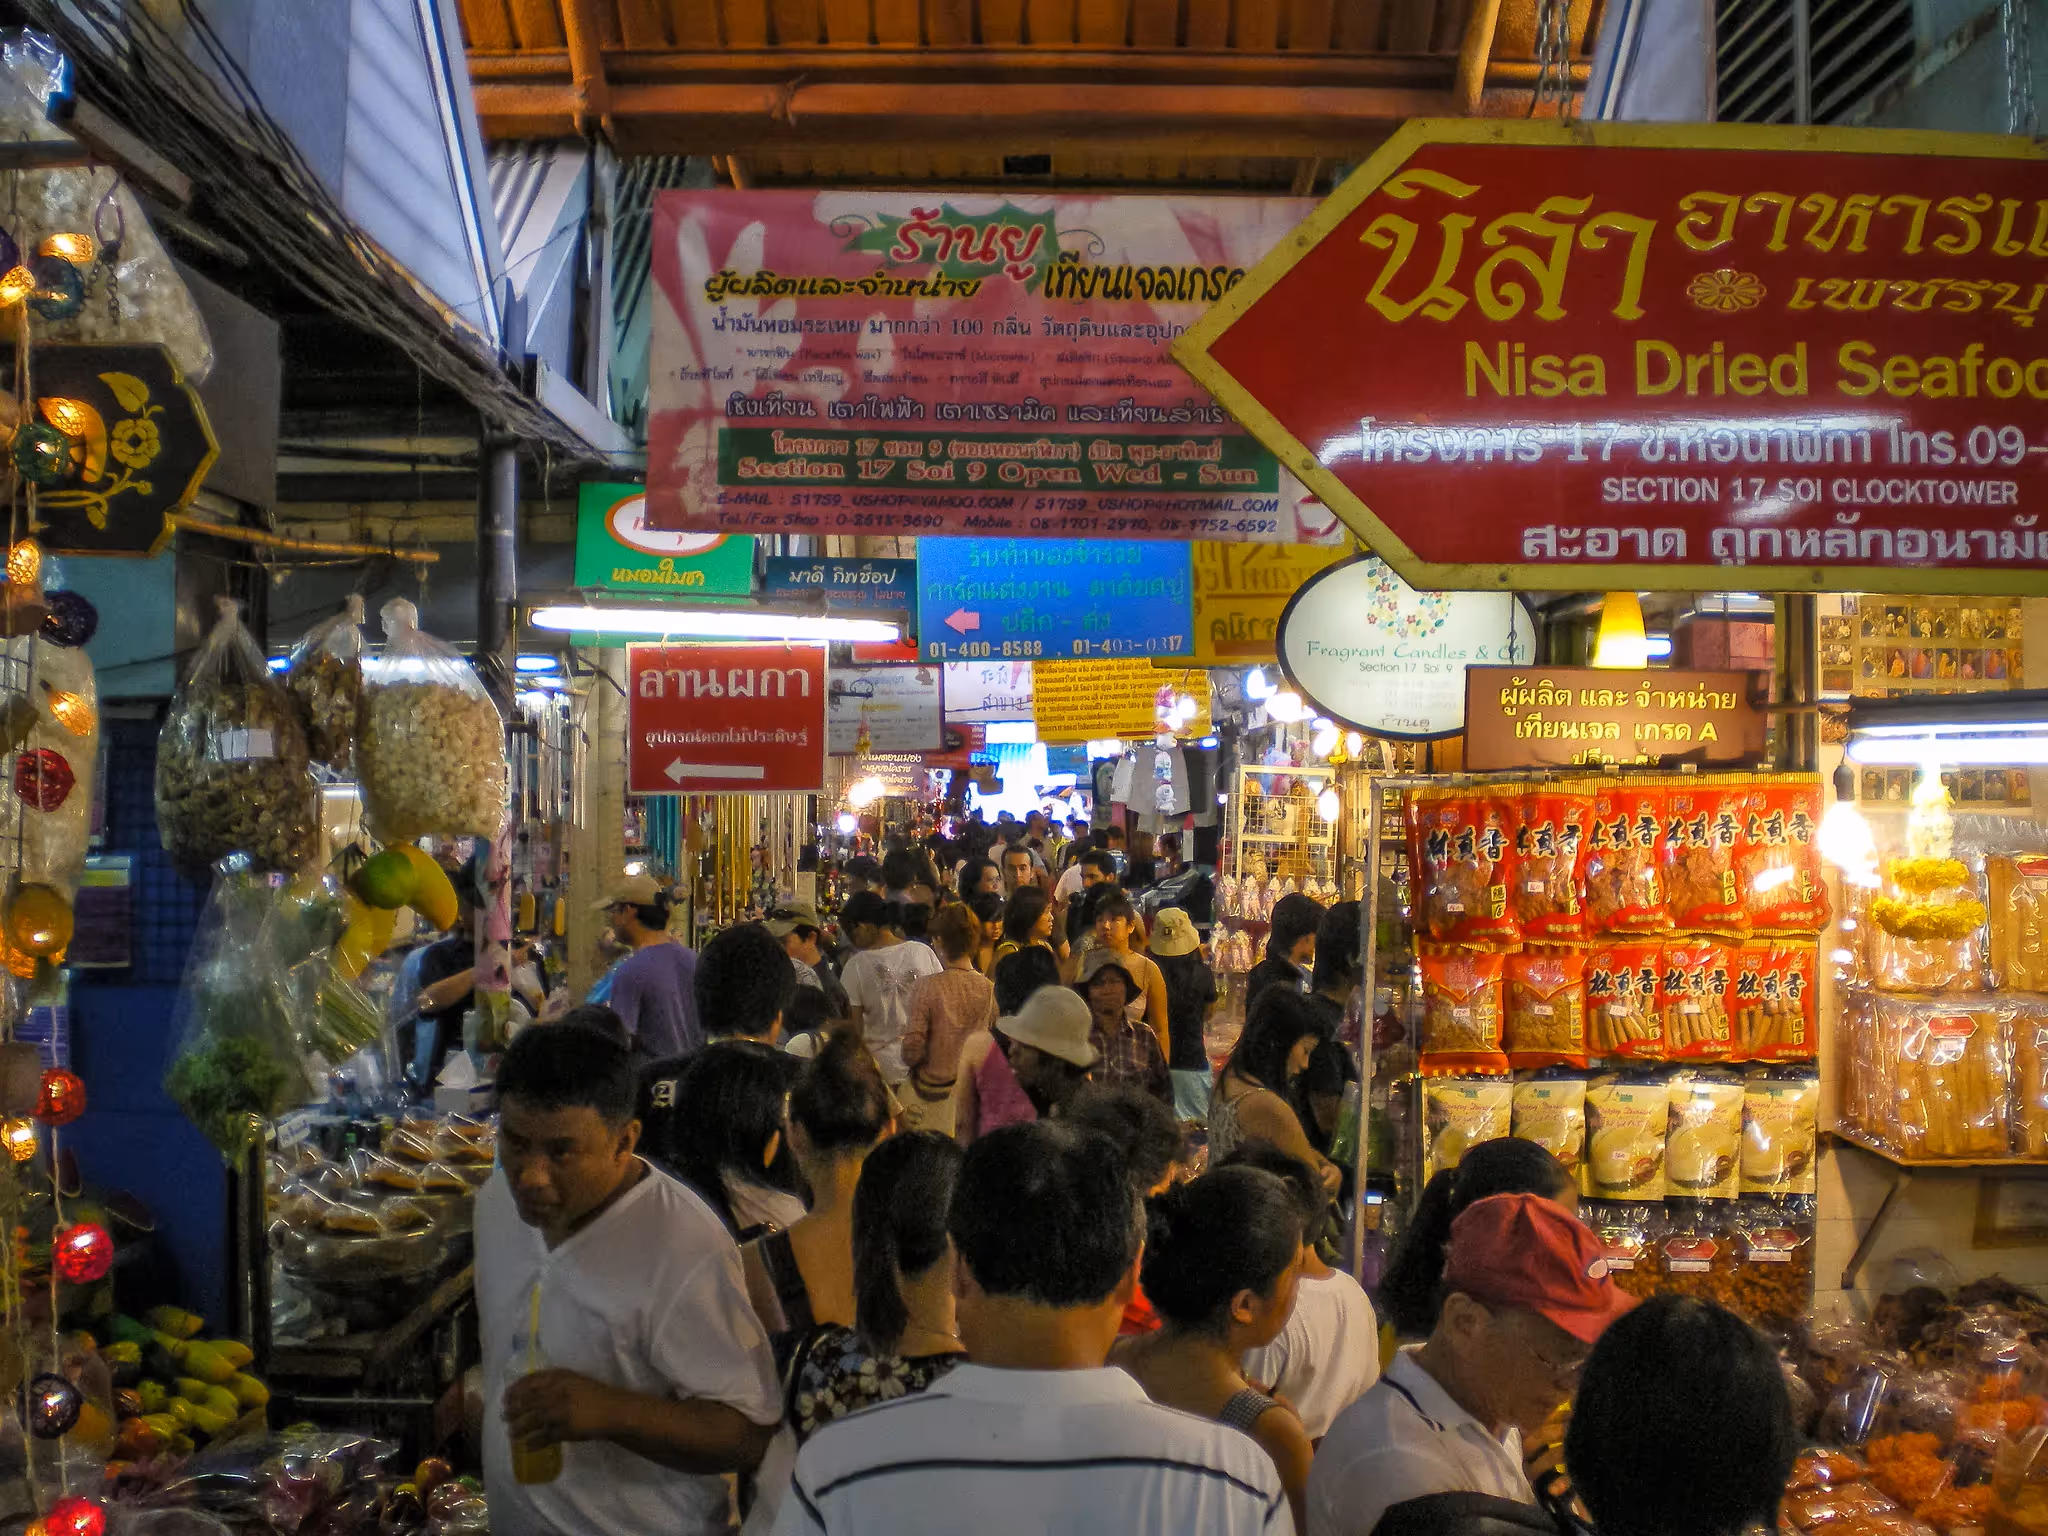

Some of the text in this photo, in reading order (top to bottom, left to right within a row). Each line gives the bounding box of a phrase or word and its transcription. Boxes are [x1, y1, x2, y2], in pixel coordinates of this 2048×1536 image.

[704, 269, 982, 302] ผู้ผลิตและจำหน่าย
[952, 318, 983, 335] 100
[993, 311, 1032, 336] กลิ่น
[1041, 317, 1191, 345] วัตถุดิบและอุปก
[1465, 341, 1606, 398] Nisa
[1636, 340, 1808, 397] Dried
[855, 437, 879, 457] 17
[928, 439, 943, 460] 9
[1361, 416, 1545, 463] โครงการ
[1566, 422, 1622, 463] 17
[738, 457, 845, 479] Section
[857, 459, 896, 480] 17
[906, 460, 955, 481] Soi
[966, 461, 987, 482] 9
[998, 461, 1082, 488] Open
[1093, 462, 1163, 484] Wed
[1199, 463, 1259, 485] Sun
[1602, 477, 2020, 506] SECTION 17 SOI CLOCKTOWER
[1522, 511, 2048, 568] สะอาด ถูกหลักอนามั
[1306, 640, 1384, 662] Fragrant
[1393, 643, 1467, 660] Candles
[1475, 644, 1489, 660] &
[639, 668, 810, 698] ลานผกา
[1360, 661, 1454, 674] Section 17 Soi 9
[1500, 676, 1738, 717] ผู้ผลิต และ จำหน่าย
[1515, 711, 1718, 742] เทียนเจล เกรด A
